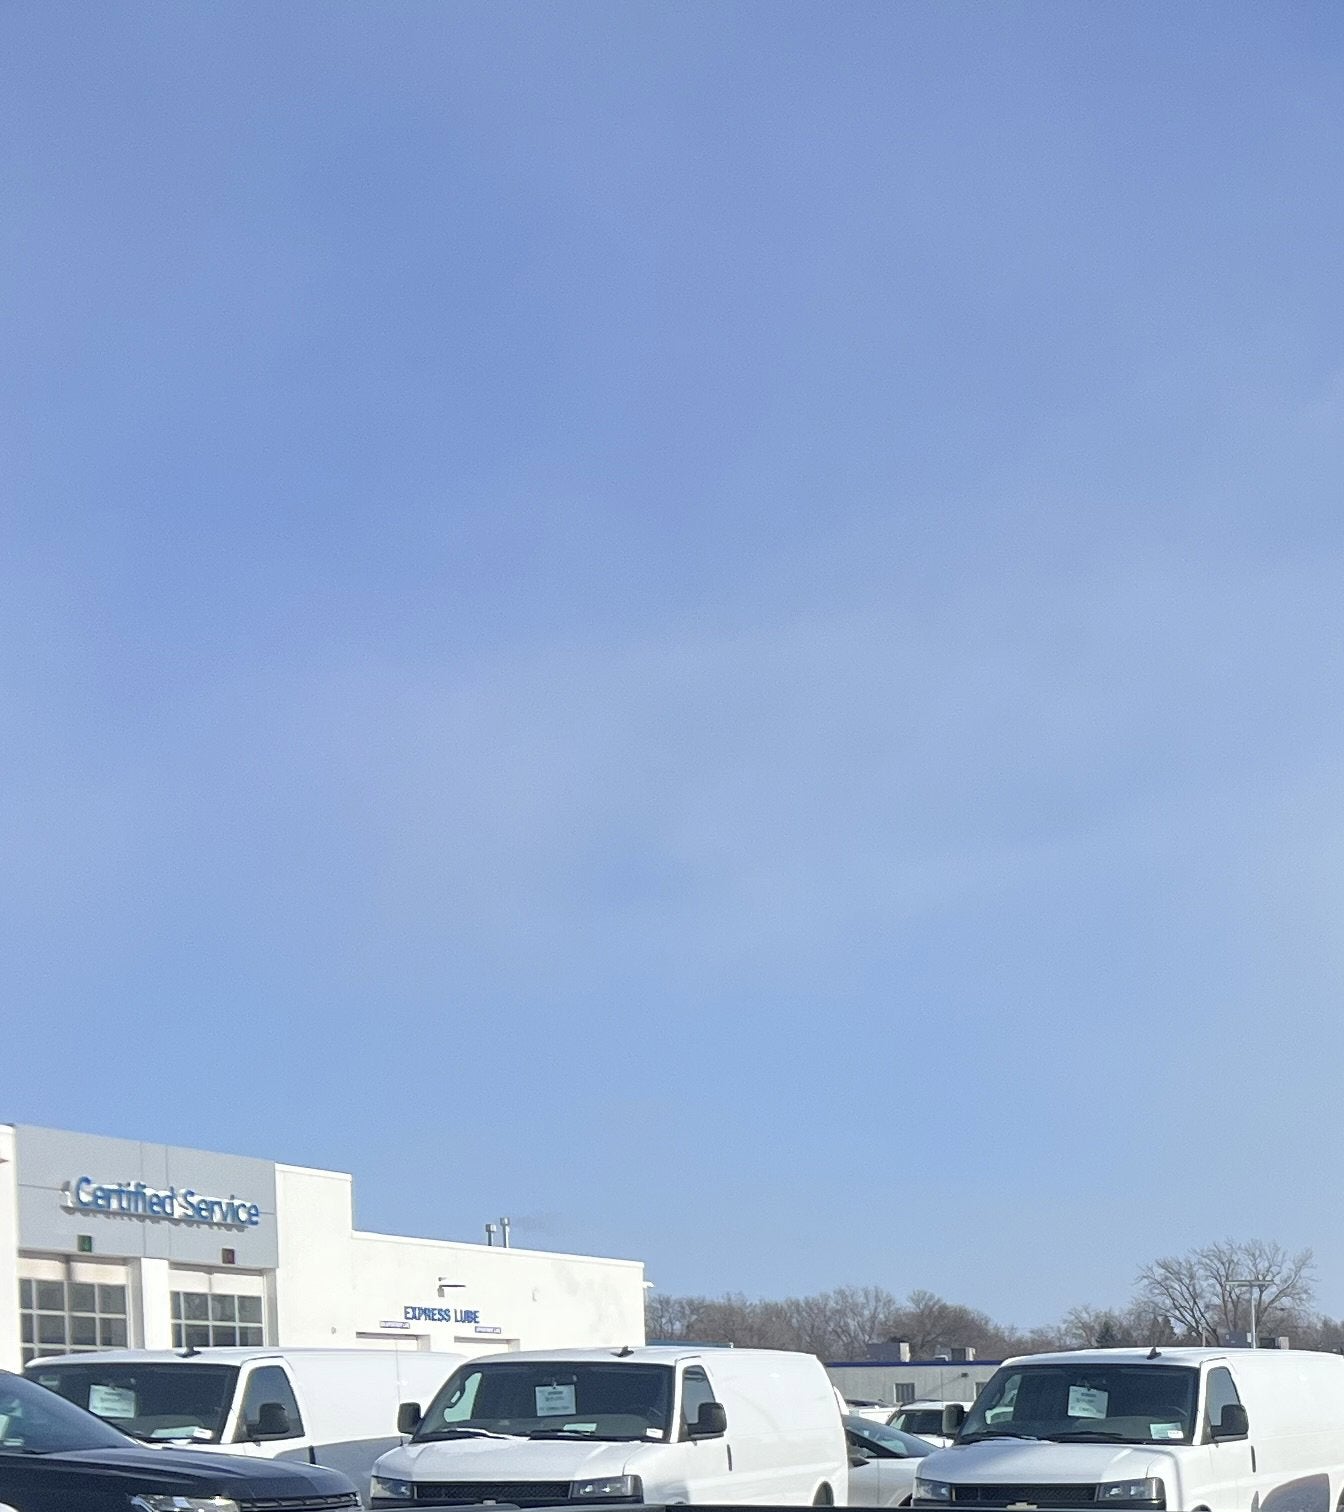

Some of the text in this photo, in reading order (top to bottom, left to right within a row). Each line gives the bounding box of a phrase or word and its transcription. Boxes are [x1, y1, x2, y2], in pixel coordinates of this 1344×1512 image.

[75, 1176, 260, 1226] Certified Service
[404, 1305, 480, 1324] EXPRESS LUBE
